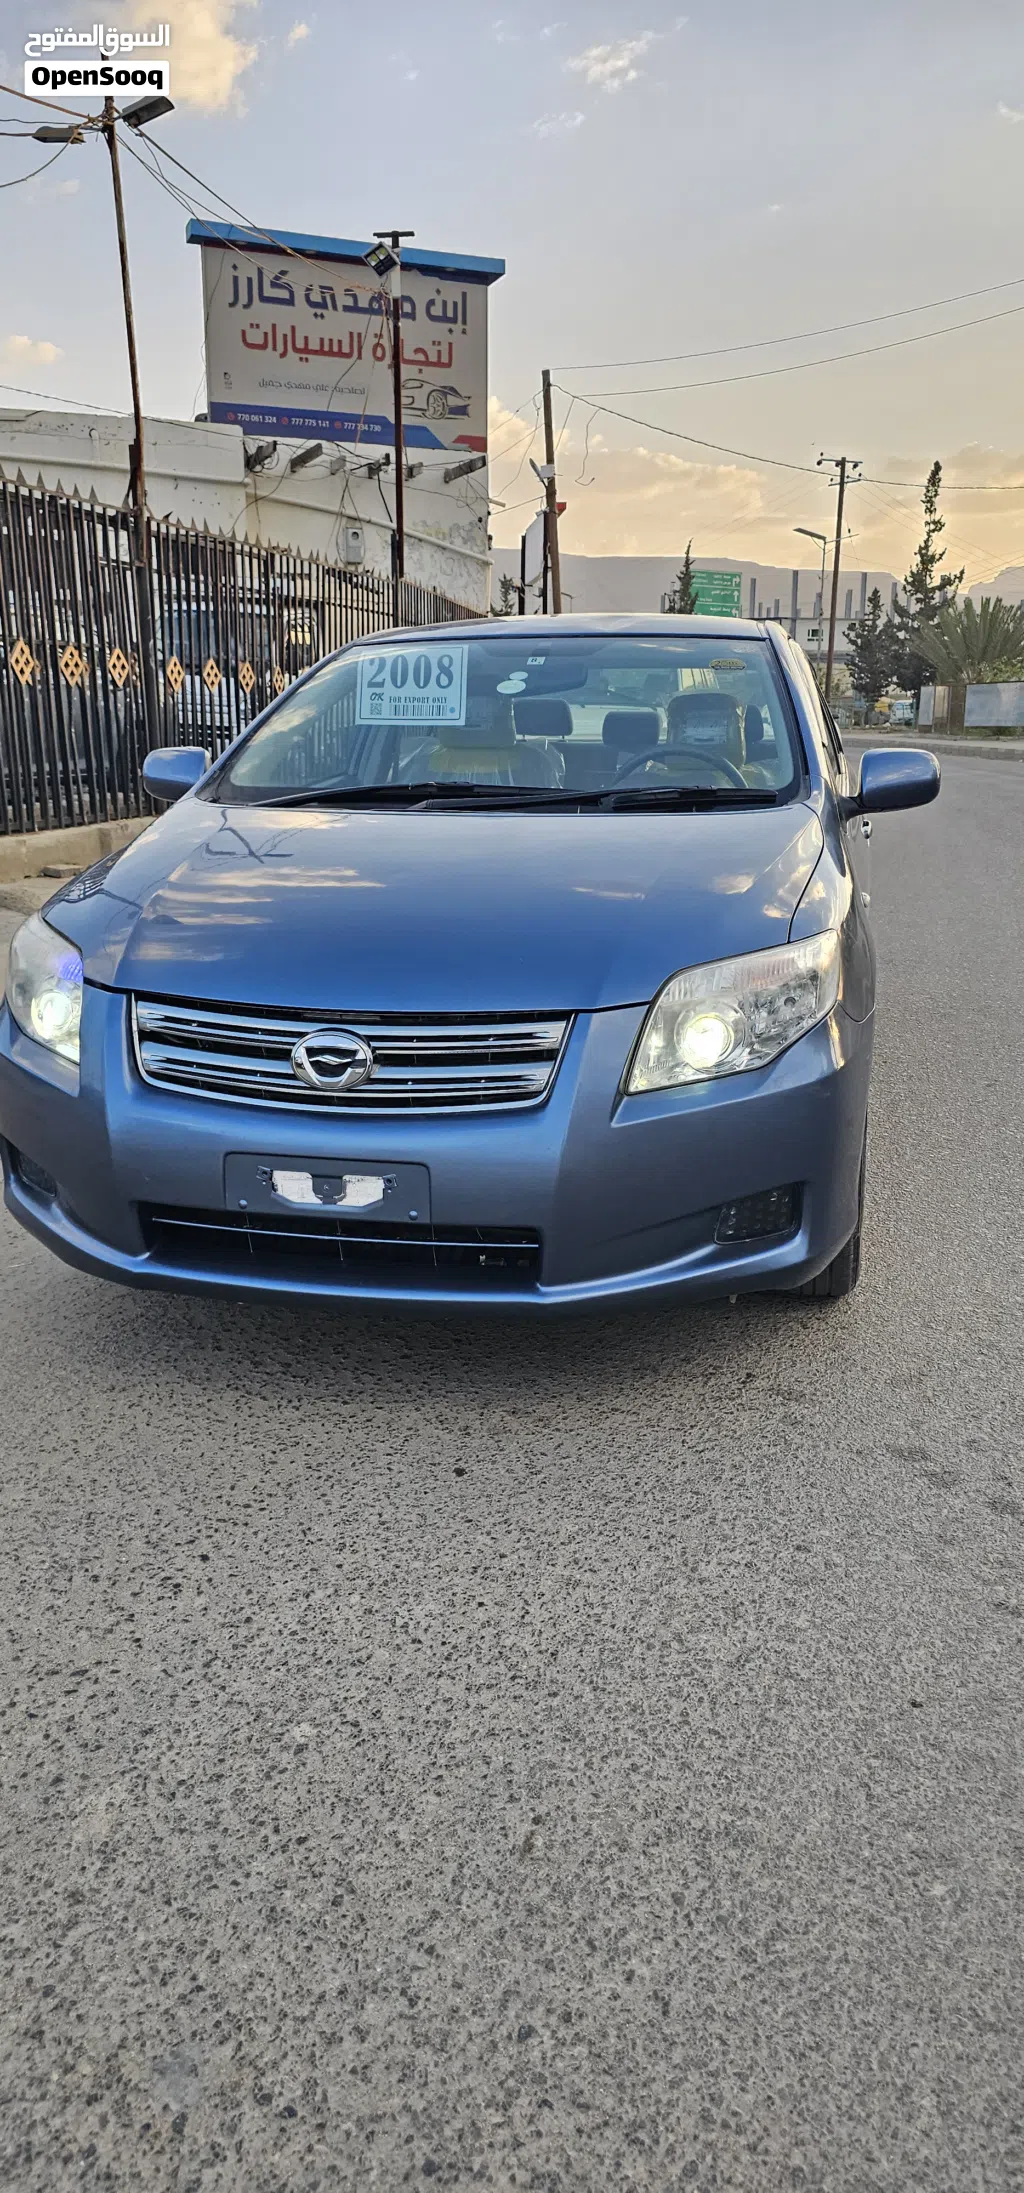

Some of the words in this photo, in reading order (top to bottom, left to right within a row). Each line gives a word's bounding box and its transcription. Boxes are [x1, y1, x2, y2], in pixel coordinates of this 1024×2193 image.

[228, 263, 296, 309] كارز
[241, 323, 363, 363] السيارات
[372, 333, 453, 375] لتجاة
[237, 413, 250, 421] 770
[291, 417, 303, 425] 777
[343, 422, 356, 430] 777
[367, 654, 454, 689] 2008
[369, 692, 385, 702] OK
[389, 696, 402, 704] FOR
[404, 696, 429, 704] EXPORT
[432, 696, 448, 704] ONLY
